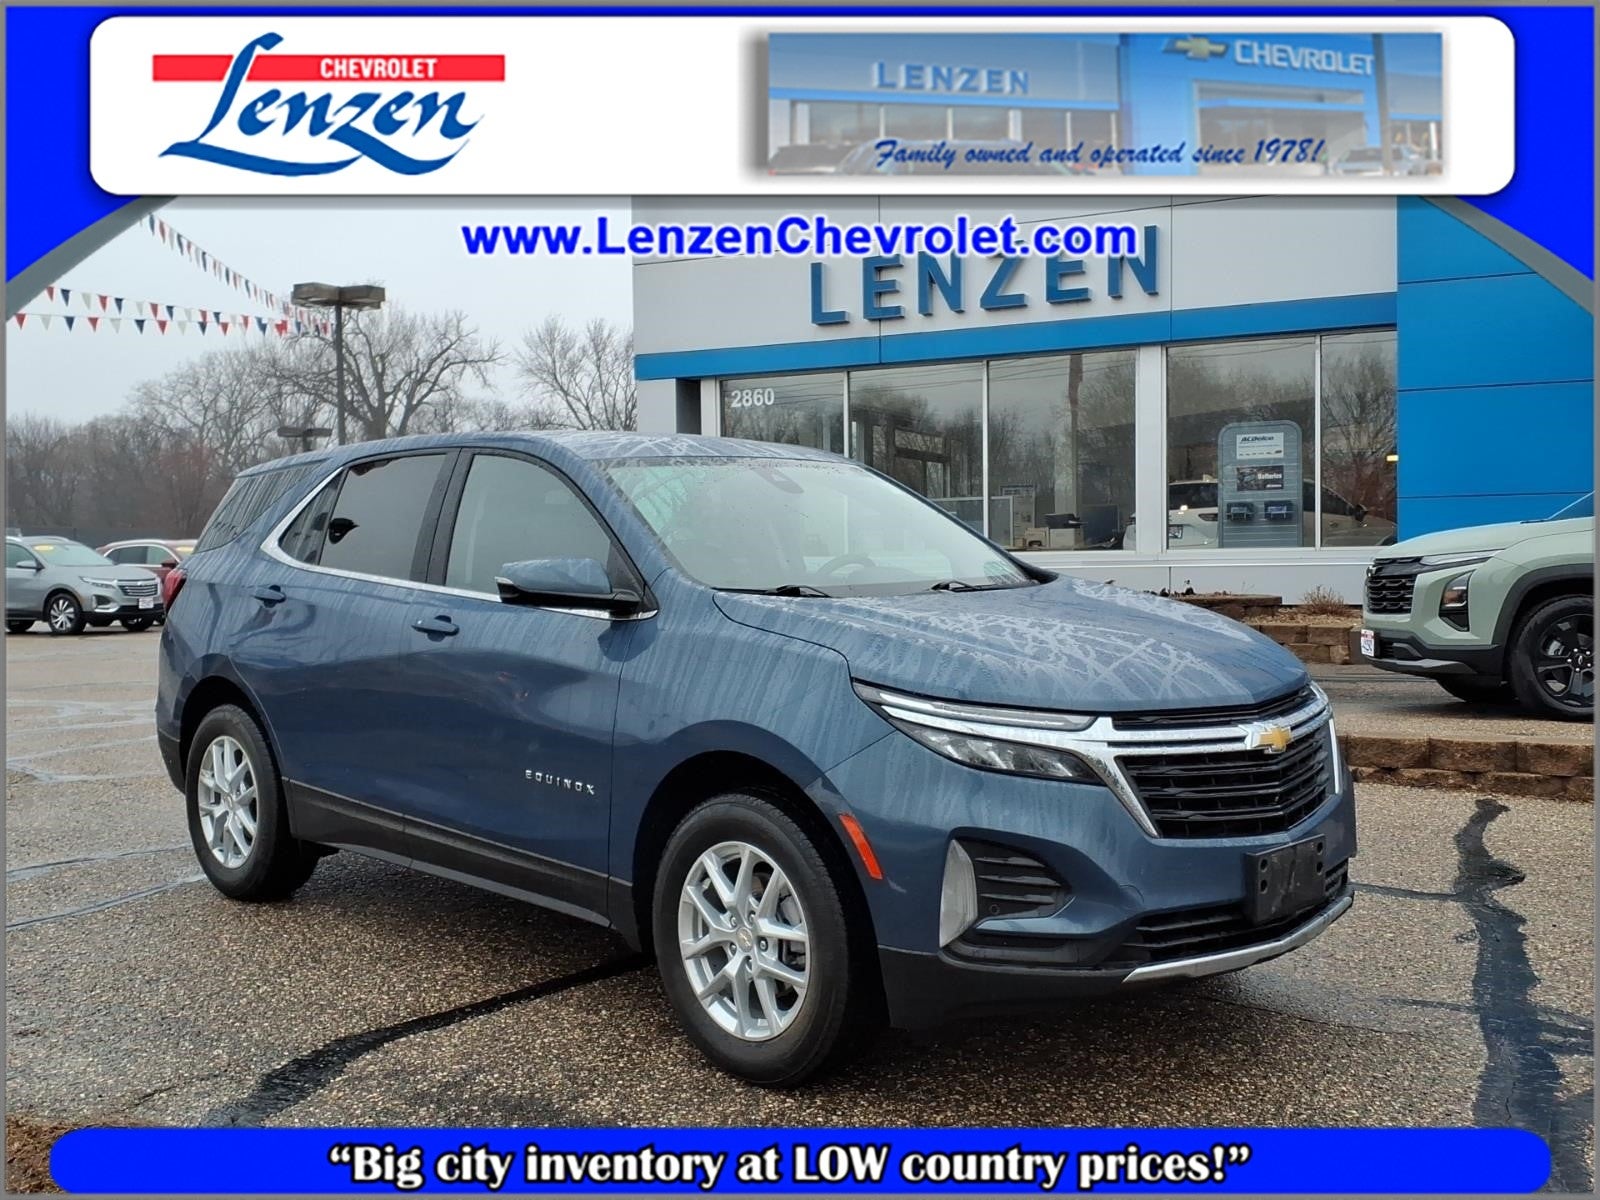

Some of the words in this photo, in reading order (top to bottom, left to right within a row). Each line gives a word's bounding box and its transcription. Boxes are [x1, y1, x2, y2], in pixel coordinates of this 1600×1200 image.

[809, 225, 1160, 326] LENZEN
[731, 388, 774, 407] 2860
[525, 770, 595, 795] EQUINOX
